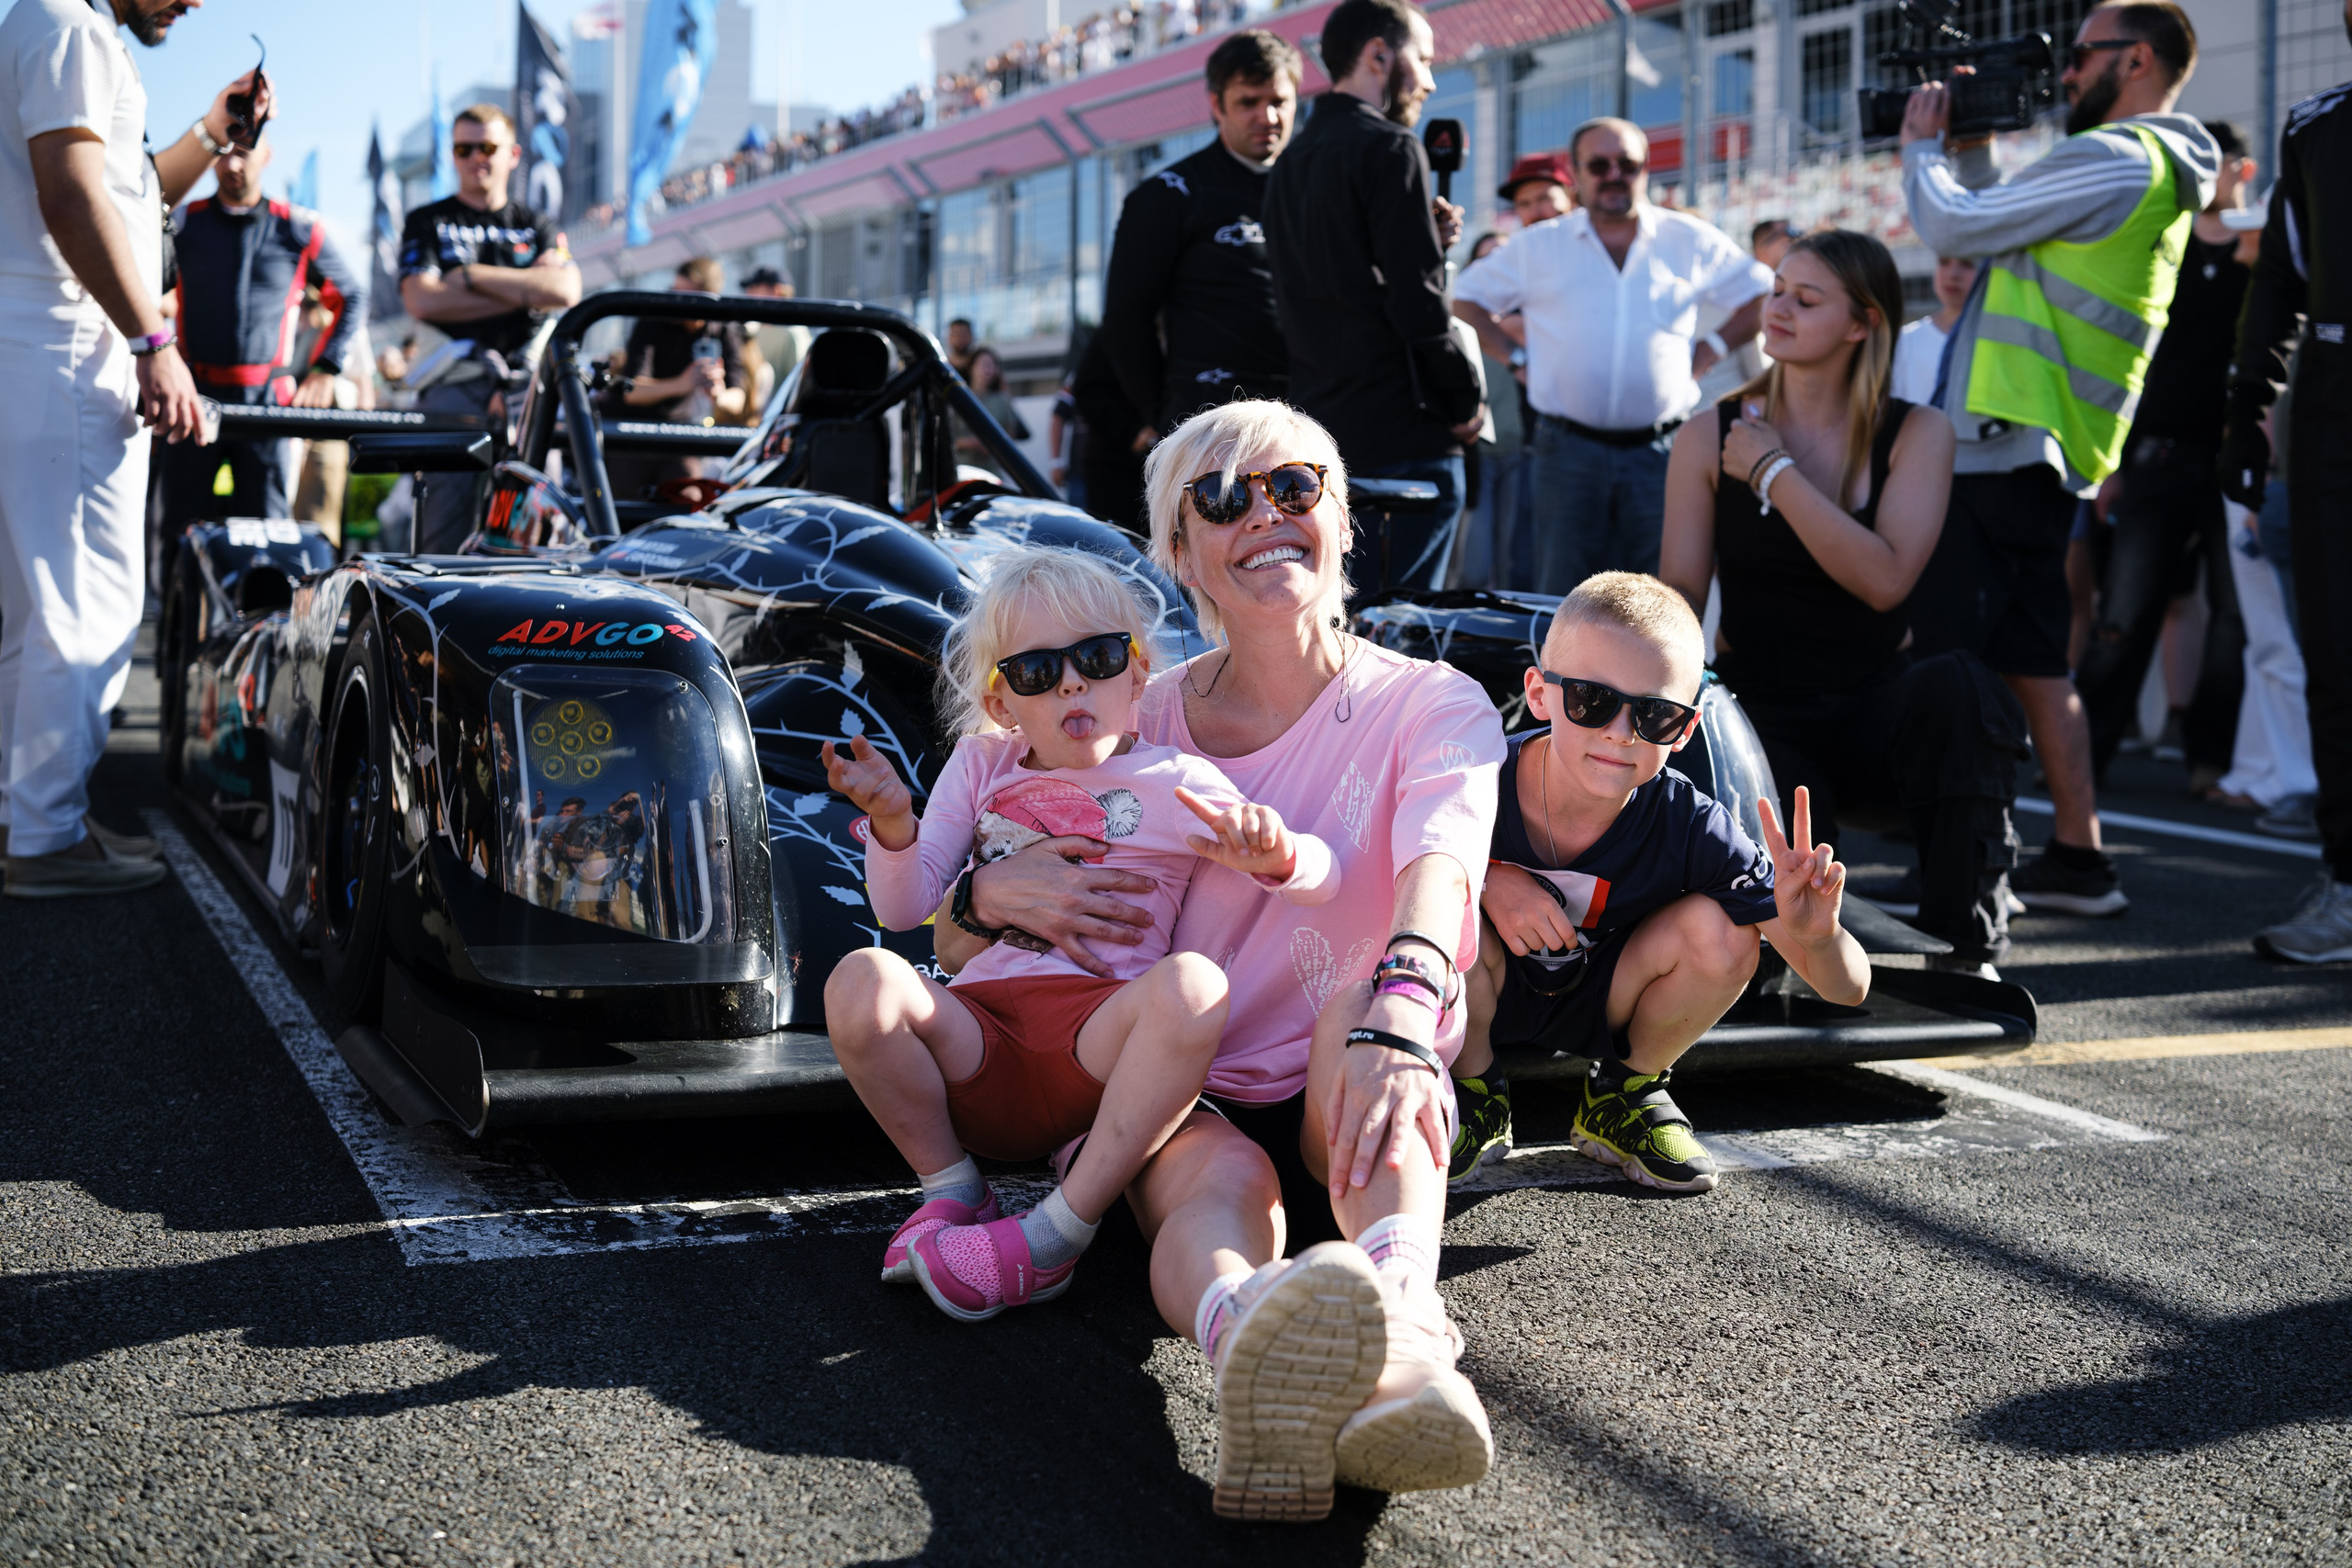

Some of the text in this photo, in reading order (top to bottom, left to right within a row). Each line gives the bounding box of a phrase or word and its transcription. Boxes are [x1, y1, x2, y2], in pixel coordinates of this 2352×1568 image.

[488, 645, 644, 661] digital marketing solutions
